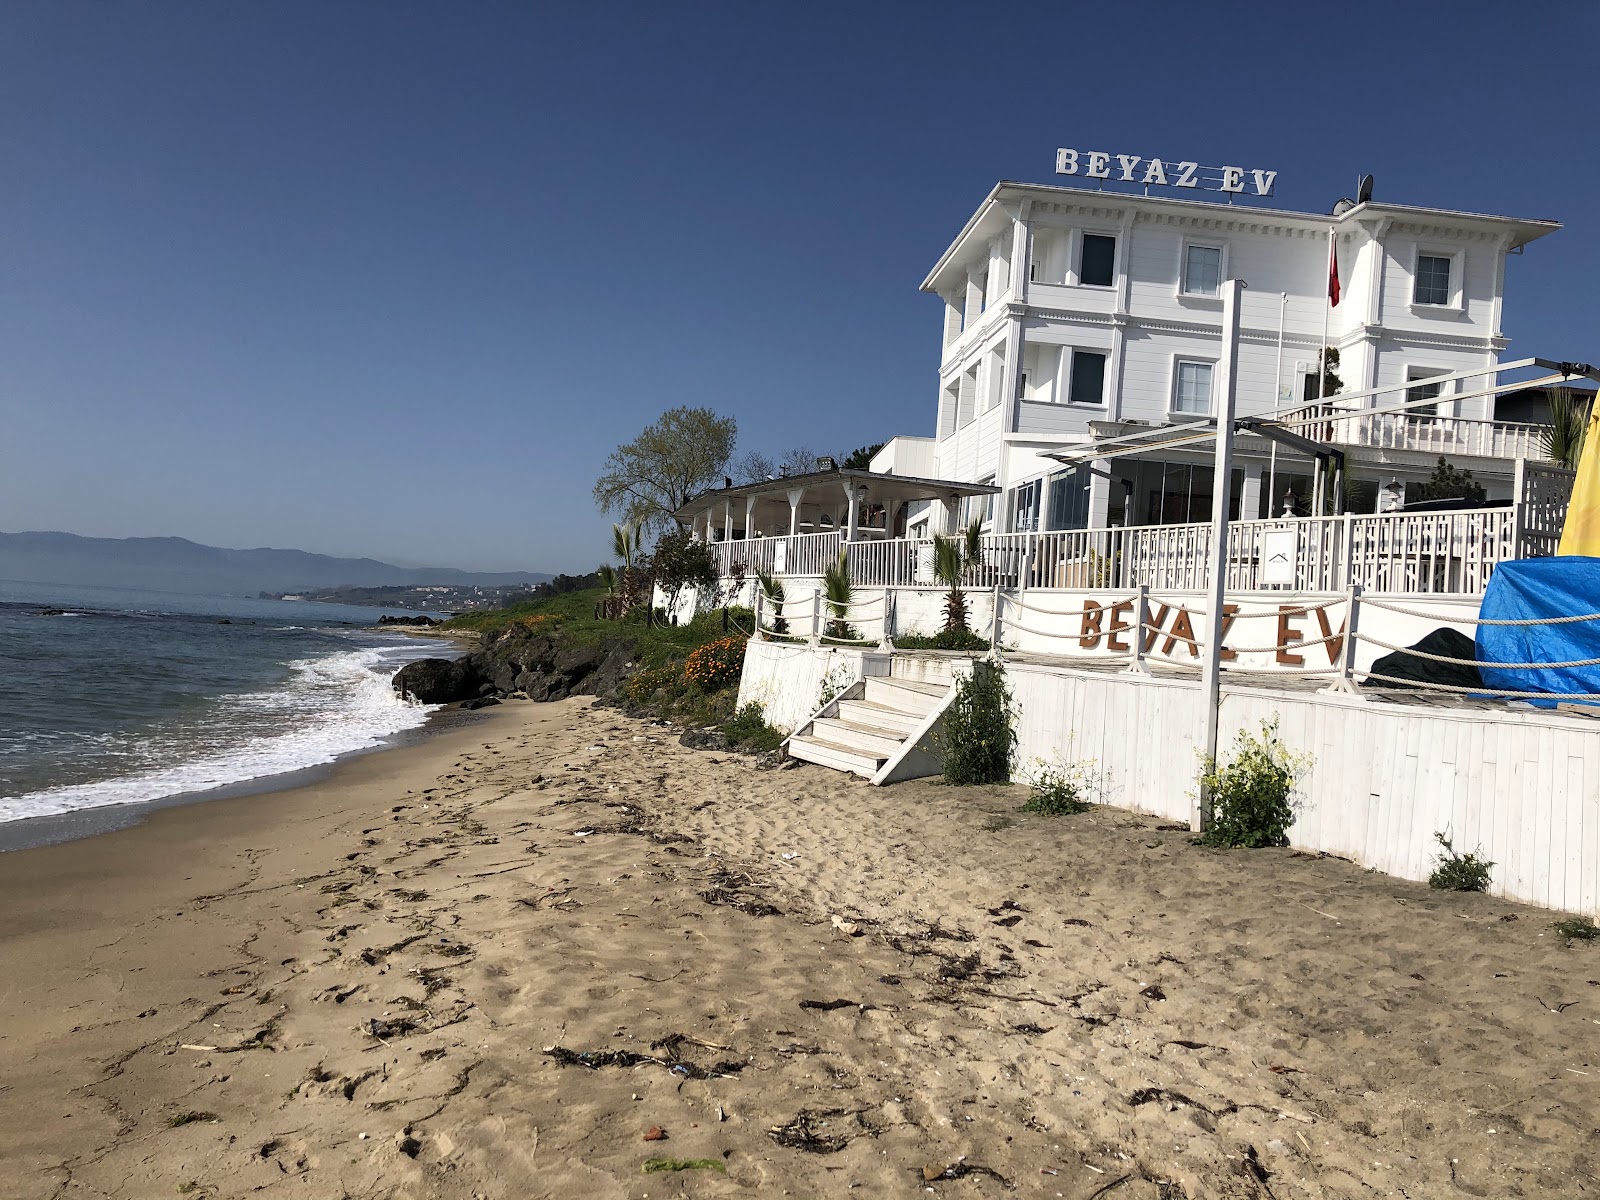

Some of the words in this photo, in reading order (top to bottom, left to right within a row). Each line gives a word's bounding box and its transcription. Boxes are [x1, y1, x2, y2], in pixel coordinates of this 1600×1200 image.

[1056, 148, 1199, 188] BEYAZ
[1221, 166, 1277, 196] EV
[1275, 605, 1346, 665] EV
